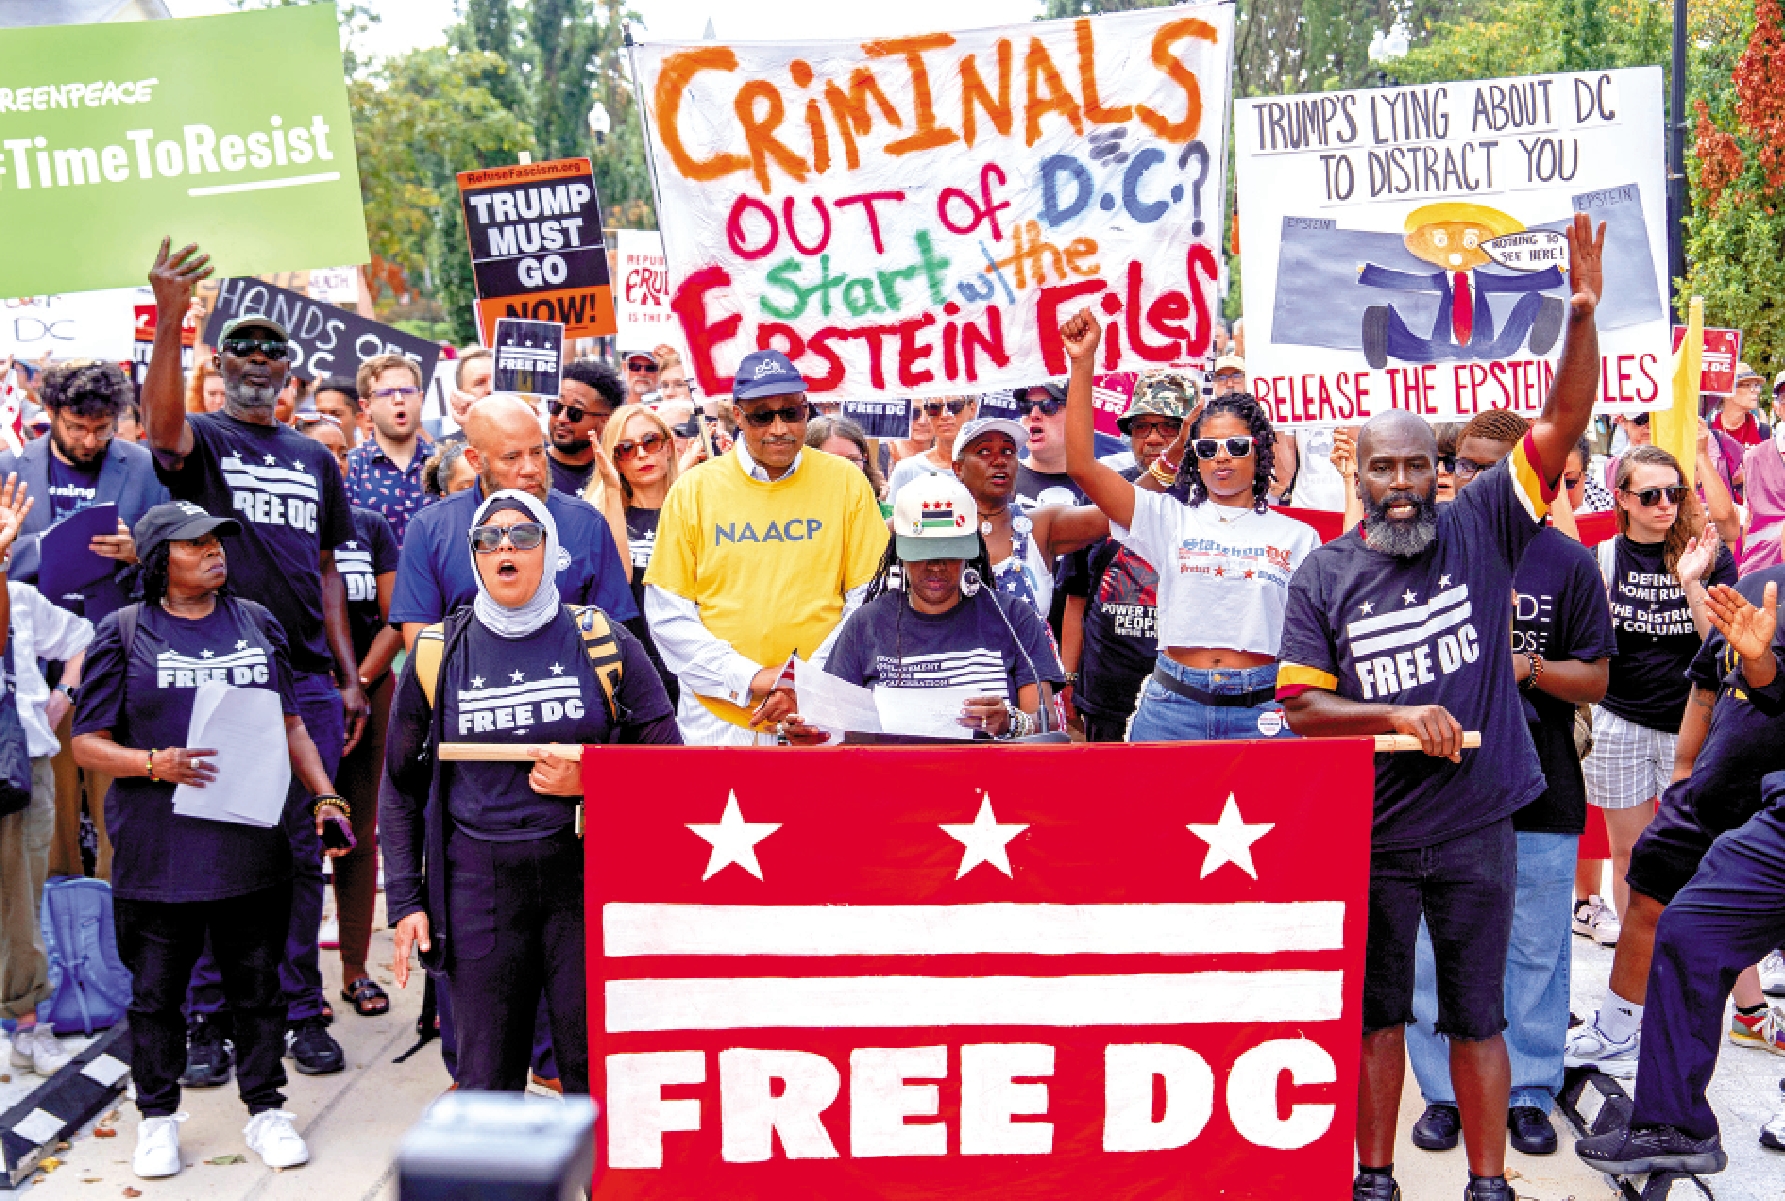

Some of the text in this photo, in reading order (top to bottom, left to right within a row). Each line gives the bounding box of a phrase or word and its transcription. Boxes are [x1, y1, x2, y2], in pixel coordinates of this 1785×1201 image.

[1252, 74, 1616, 150] TRUMP'S LYING ABOUT DC
[0, 115, 333, 189] TimeToResist
[1320, 138, 1578, 201] TO DISTRACT YOU
[467, 163, 581, 185] RefuseFascism.org
[469, 184, 591, 223] TRUMP
[1577, 188, 1633, 210] EPSTEIN
[488, 218, 584, 255] MUST
[727, 190, 905, 259] OUT
[517, 255, 567, 287] GO
[760, 229, 952, 320] Start
[14, 317, 76, 342] DC
[216, 278, 345, 349] HANDS
[1253, 372, 1371, 423] RELEASE
[1386, 364, 1438, 414] THE
[287, 498, 317, 533] DC
[715, 519, 823, 546] NAACP
[1101, 603, 1143, 616] POWER
[157, 665, 269, 689] FREE DC
[1355, 622, 1480, 700] FREE DC
[458, 698, 585, 735] FREE DC
[604, 1037, 1338, 1170] FREE DC
